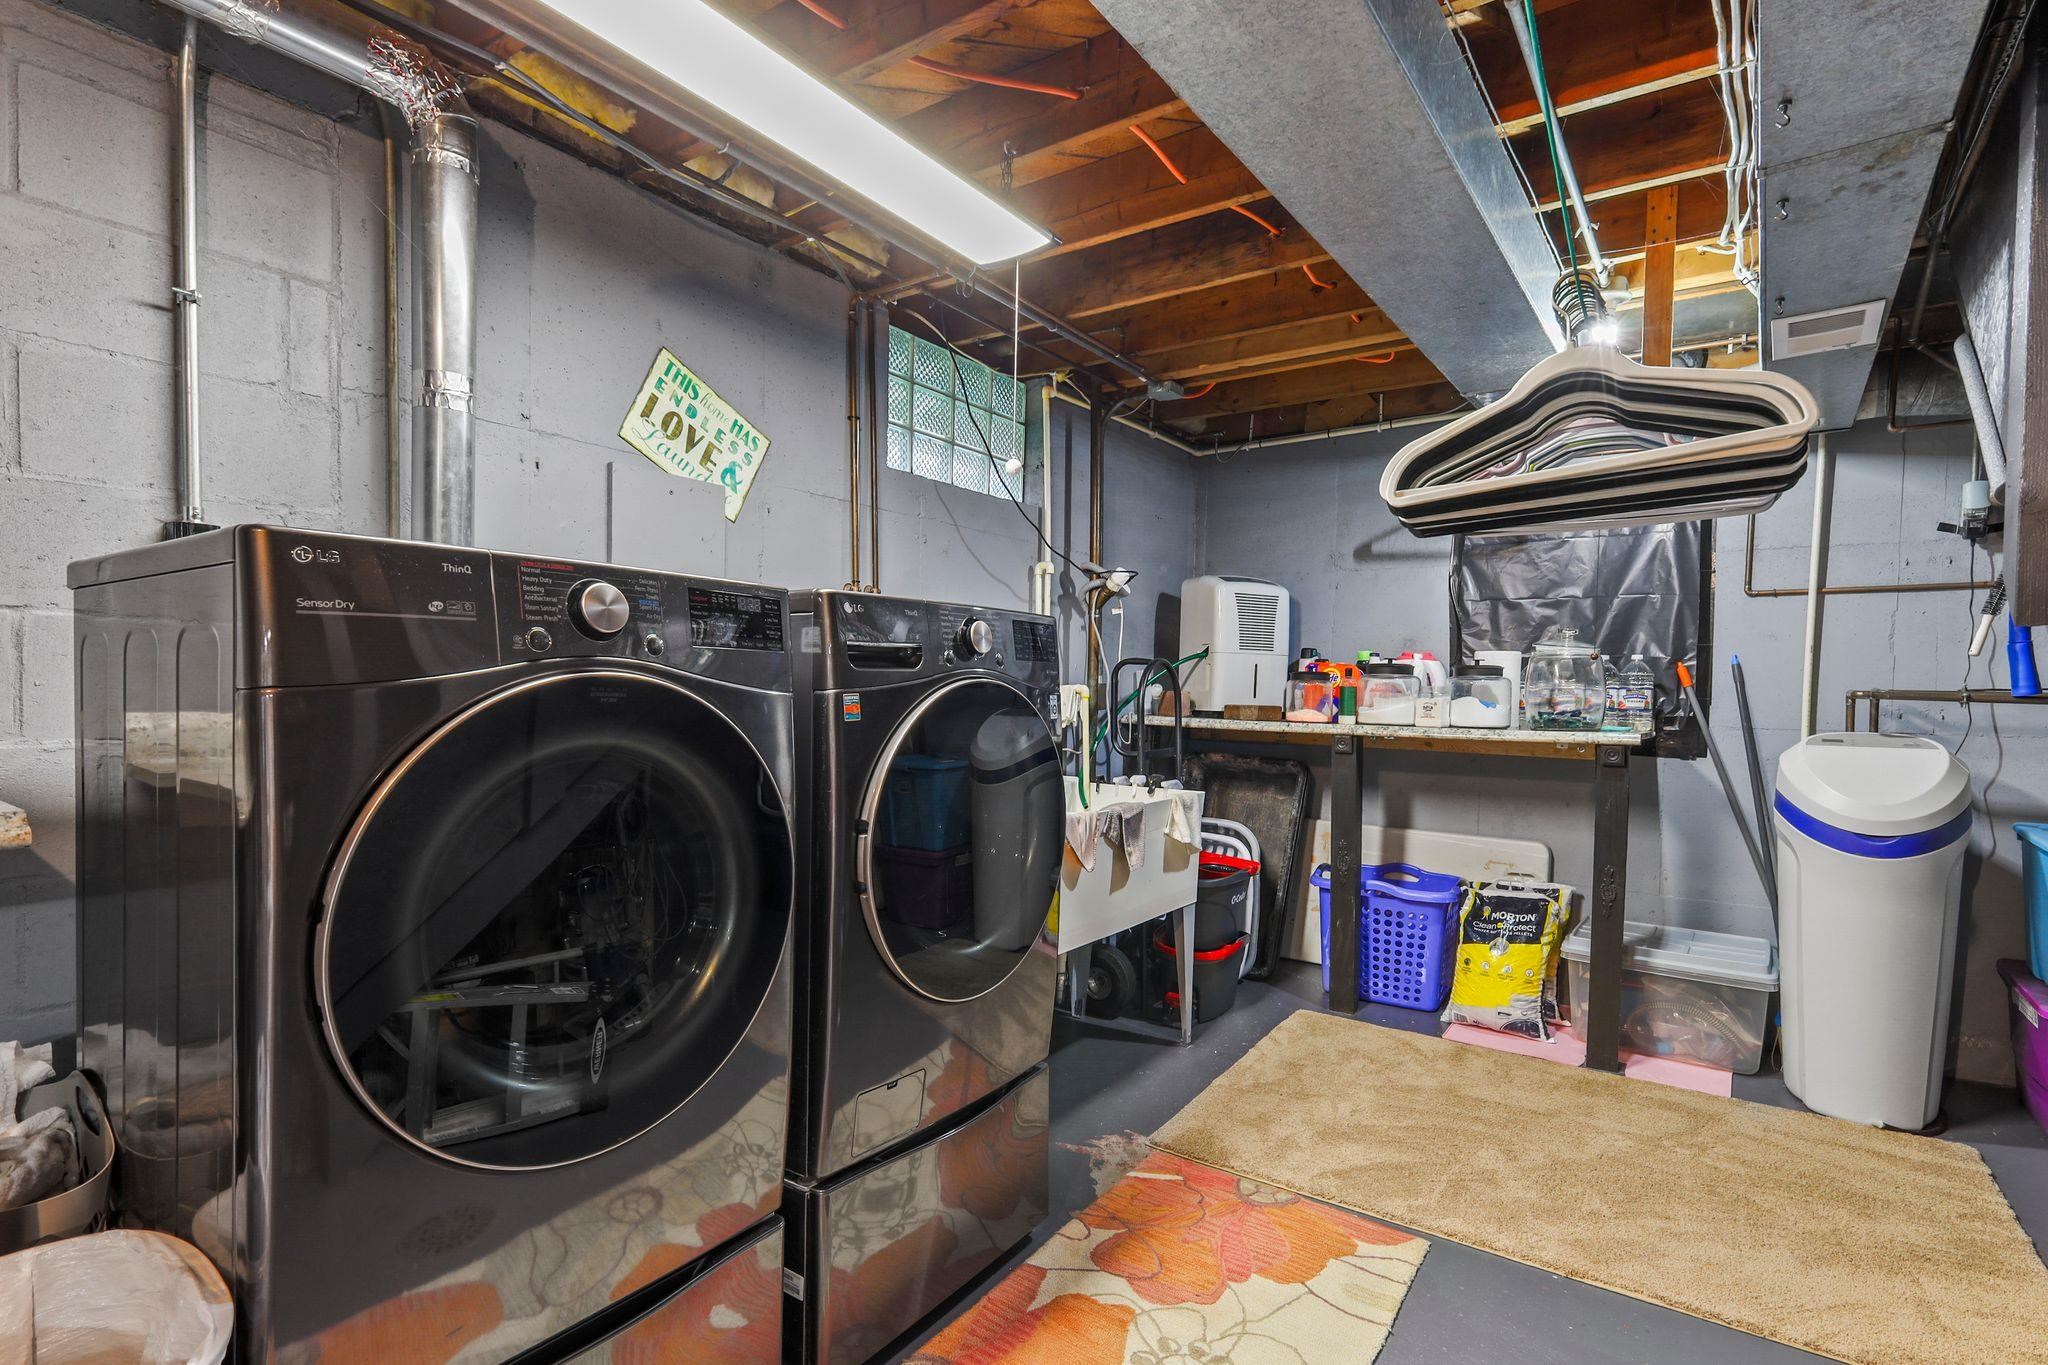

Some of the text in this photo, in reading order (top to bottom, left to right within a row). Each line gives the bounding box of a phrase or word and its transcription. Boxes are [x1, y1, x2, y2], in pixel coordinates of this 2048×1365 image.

[664, 358, 760, 452] THIS home HAS
[655, 376, 753, 467] ENDLESS
[640, 392, 723, 473] LOVE
[316, 549, 341, 563] LG
[441, 562, 473, 574] ThinQ
[522, 575, 539, 583] Heavy
[522, 585, 545, 593] Bedding
[853, 603, 865, 613] LG
[1491, 911, 1536, 922] MORTON
[1472, 921, 1537, 932] Clean Protect
